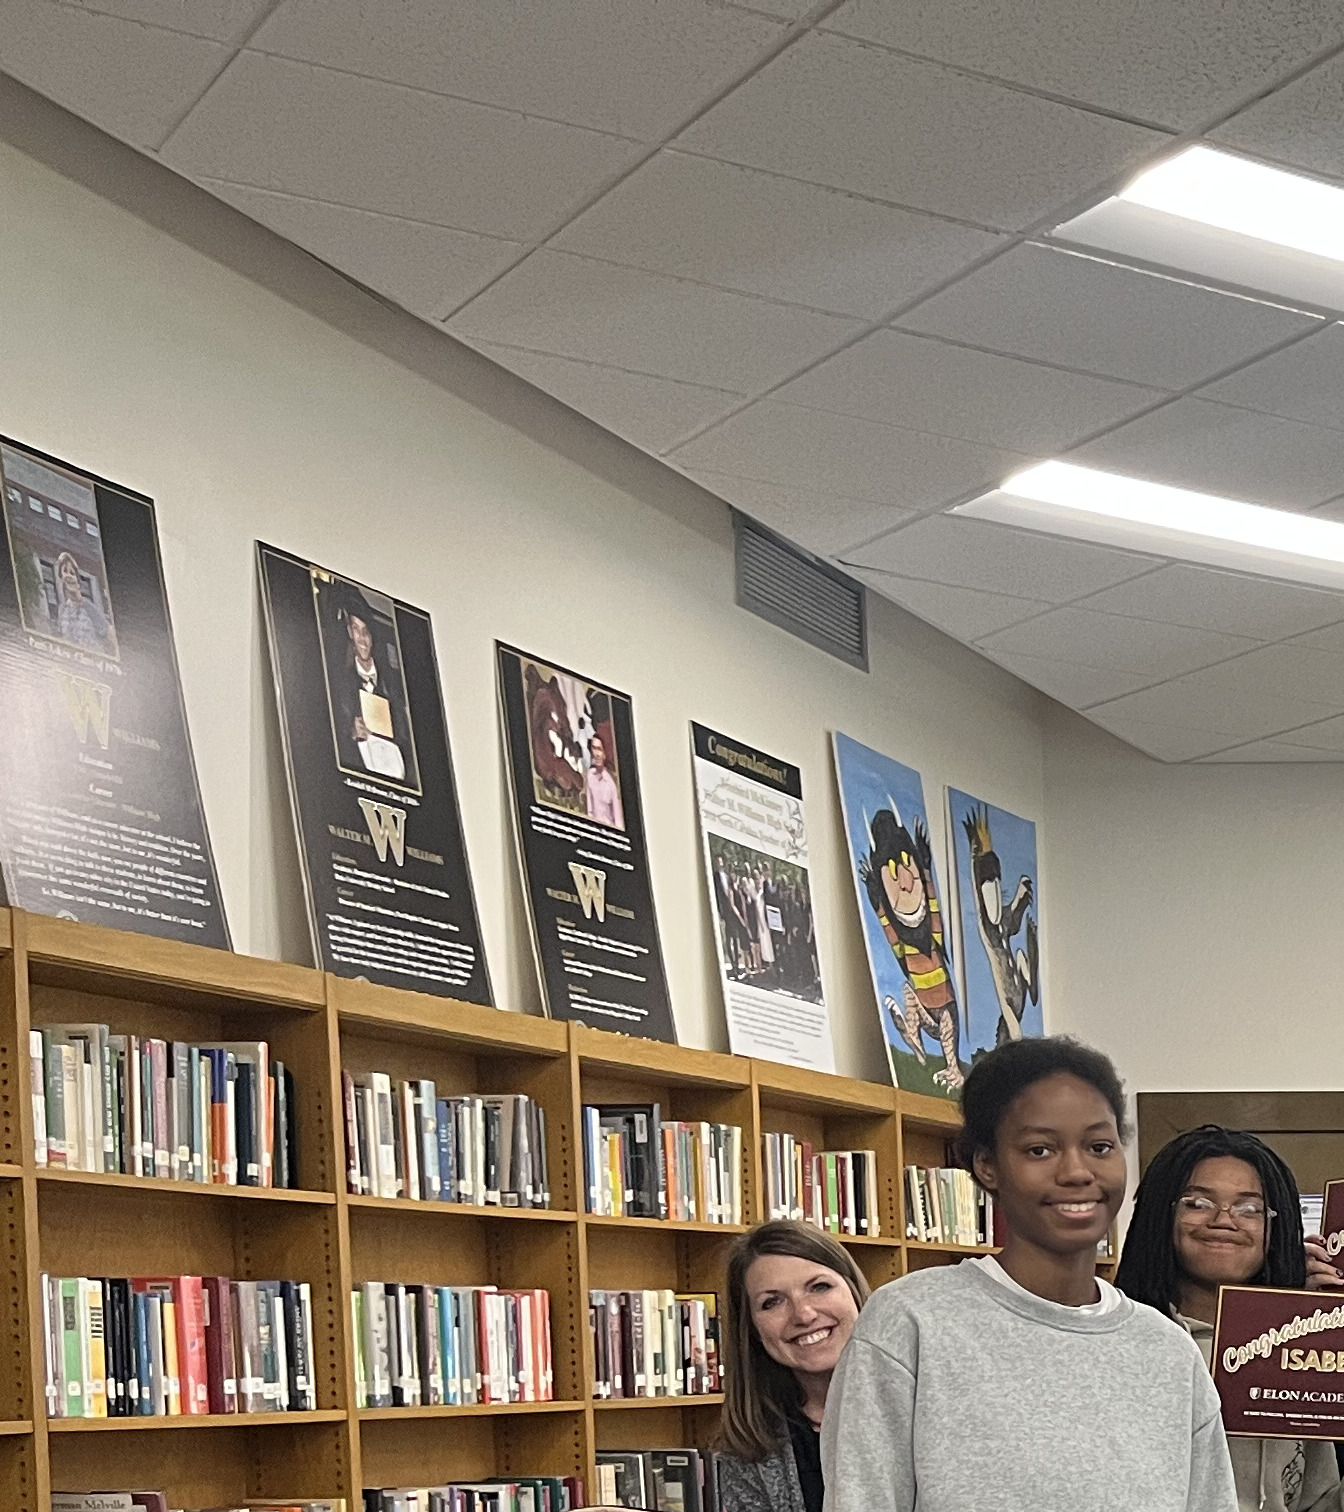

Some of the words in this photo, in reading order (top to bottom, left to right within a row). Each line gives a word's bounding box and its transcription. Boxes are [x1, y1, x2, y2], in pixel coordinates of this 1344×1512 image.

[357, 797, 407, 867] W
[567, 862, 607, 923] W
[1263, 1389, 1299, 1401] ELON
